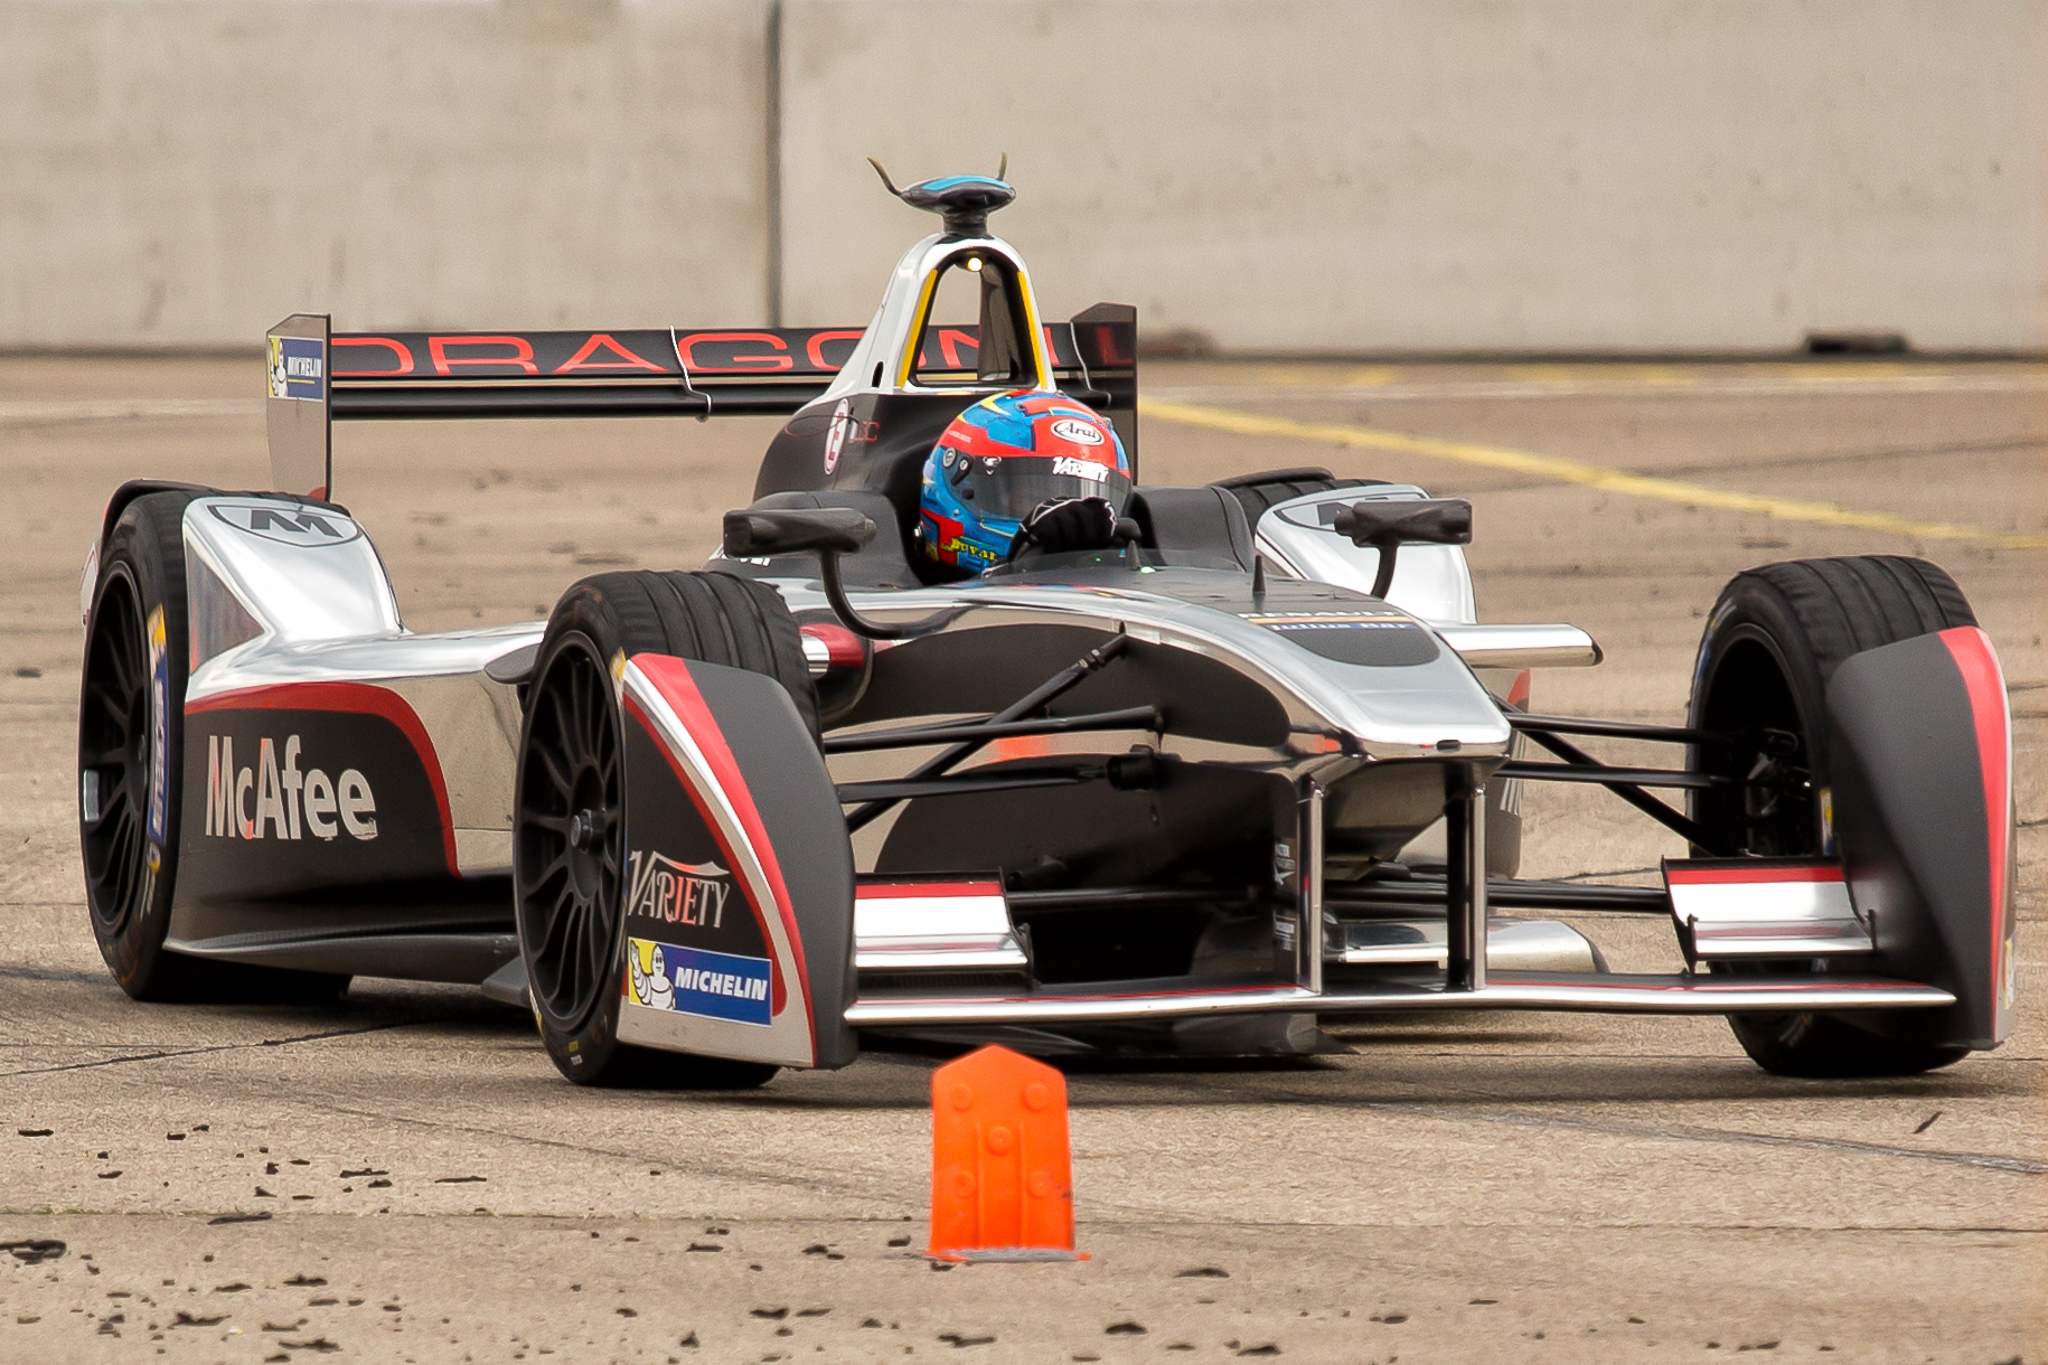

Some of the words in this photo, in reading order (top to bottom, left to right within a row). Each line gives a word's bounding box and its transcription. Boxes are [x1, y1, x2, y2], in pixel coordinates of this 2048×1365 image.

[1059, 422, 1097, 439] Arai
[205, 734, 379, 841] McAfee
[627, 850, 731, 929] VARIETY
[674, 965, 769, 1001] MICHELIN
